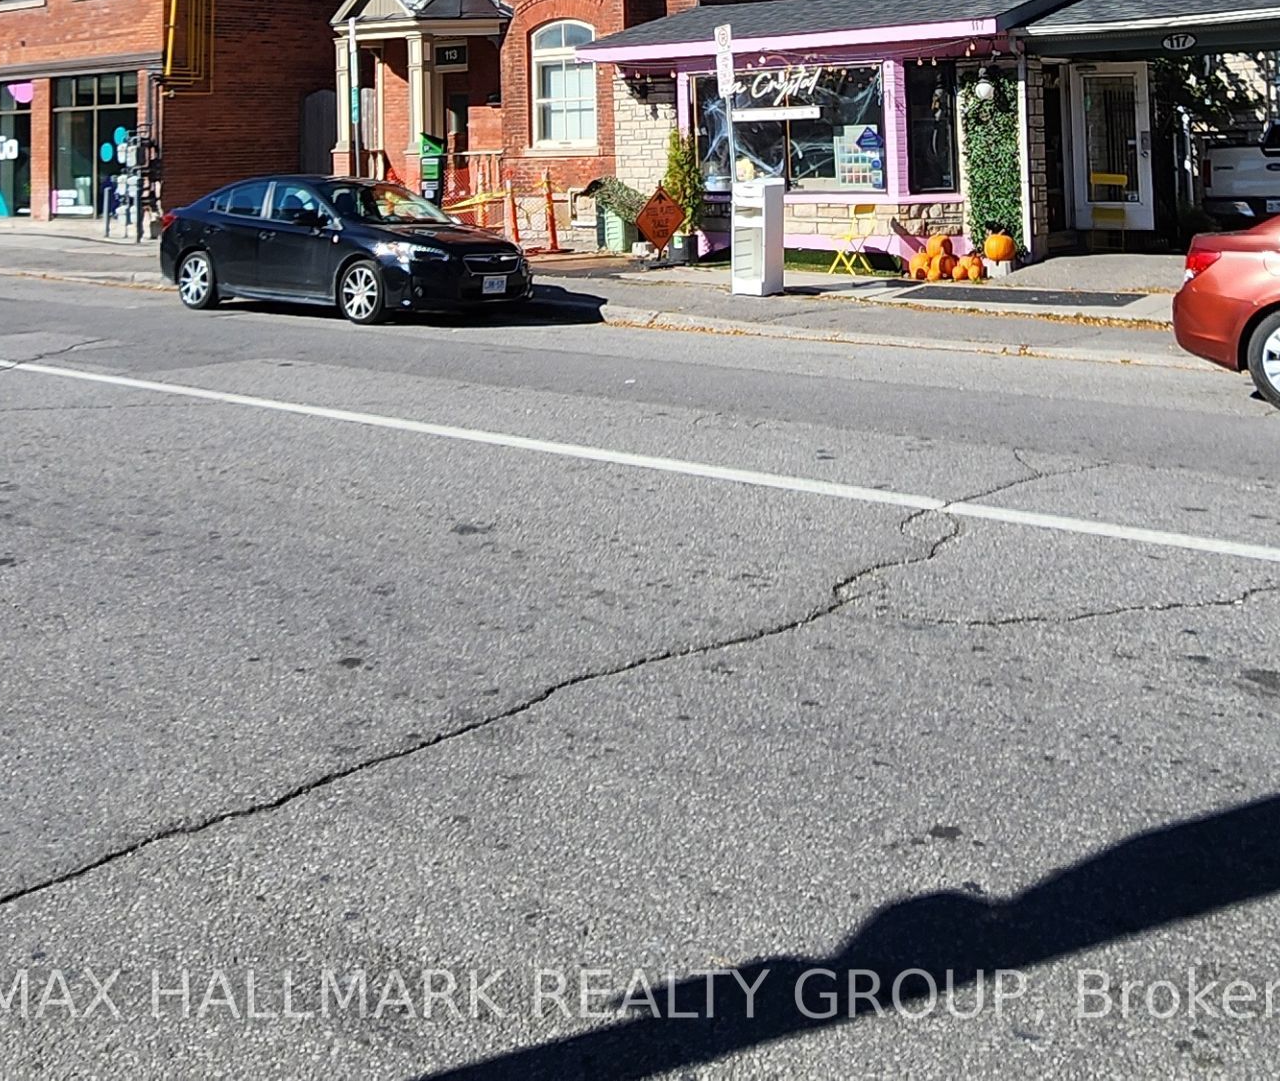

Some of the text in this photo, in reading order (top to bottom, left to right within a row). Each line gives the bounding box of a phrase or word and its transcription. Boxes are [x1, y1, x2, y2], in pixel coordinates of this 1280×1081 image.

[1168, 34, 1189, 49] 117
[444, 49, 458, 61] 113
[751, 67, 822, 107] Crystal
